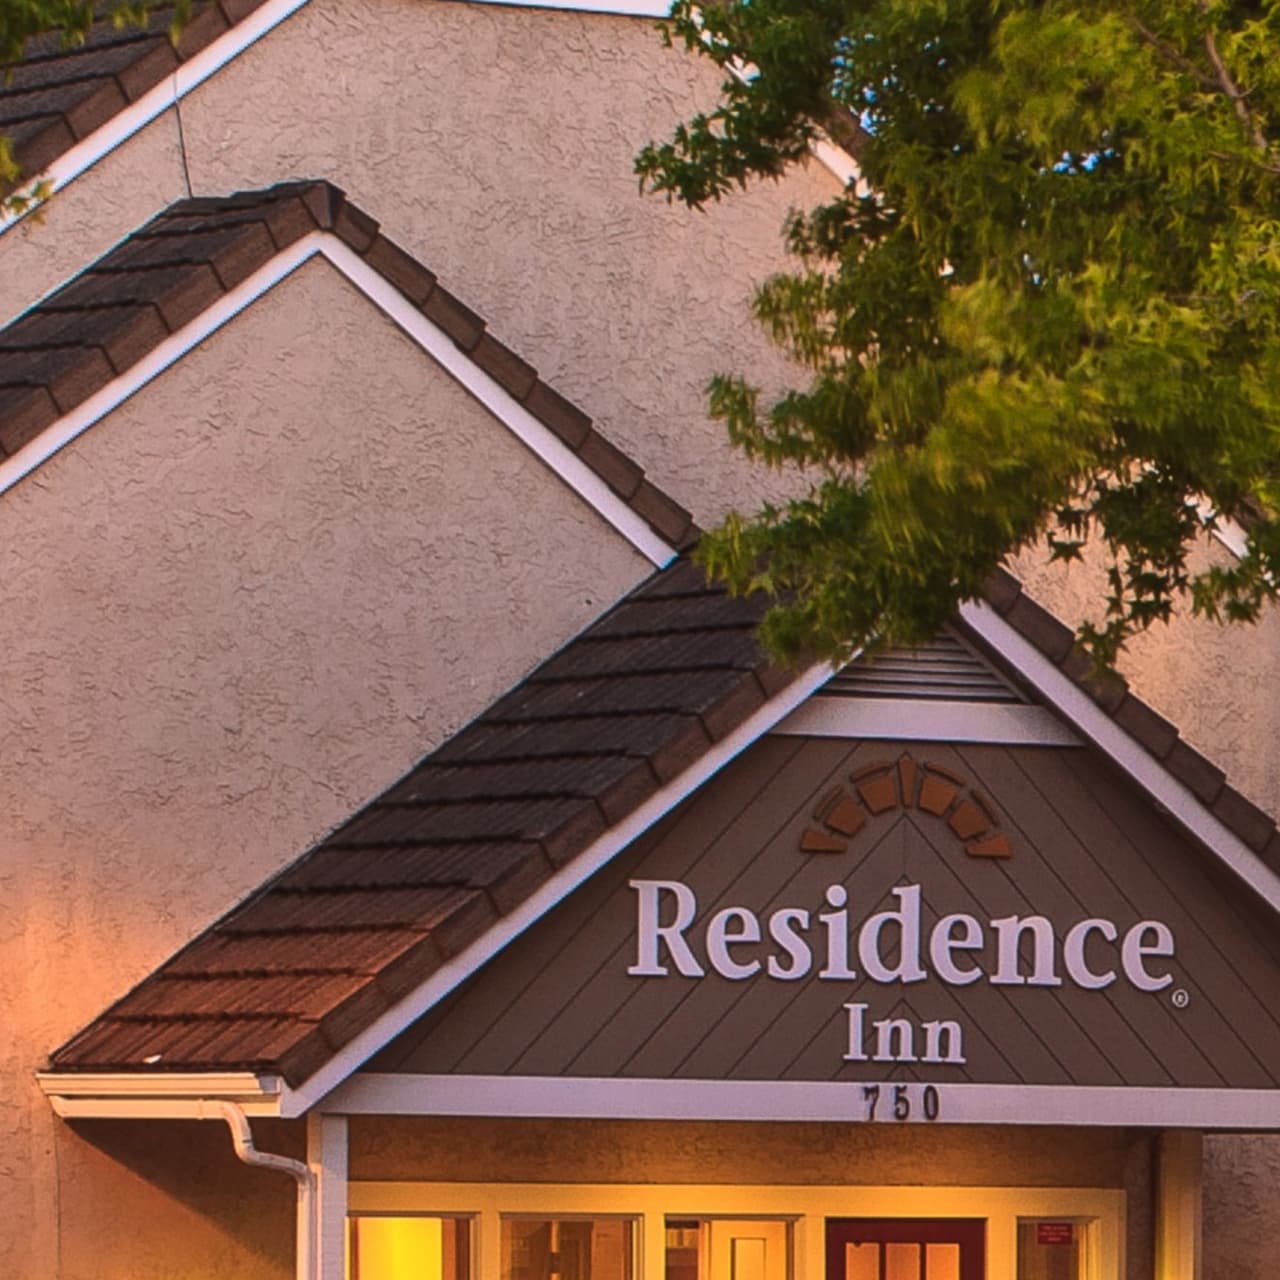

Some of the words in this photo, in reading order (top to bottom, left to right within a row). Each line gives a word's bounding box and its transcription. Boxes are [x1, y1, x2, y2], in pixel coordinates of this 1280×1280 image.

[627, 879, 1176, 992] Residence
[842, 1002, 966, 1064] Inn
[862, 1085, 940, 1121] 750
